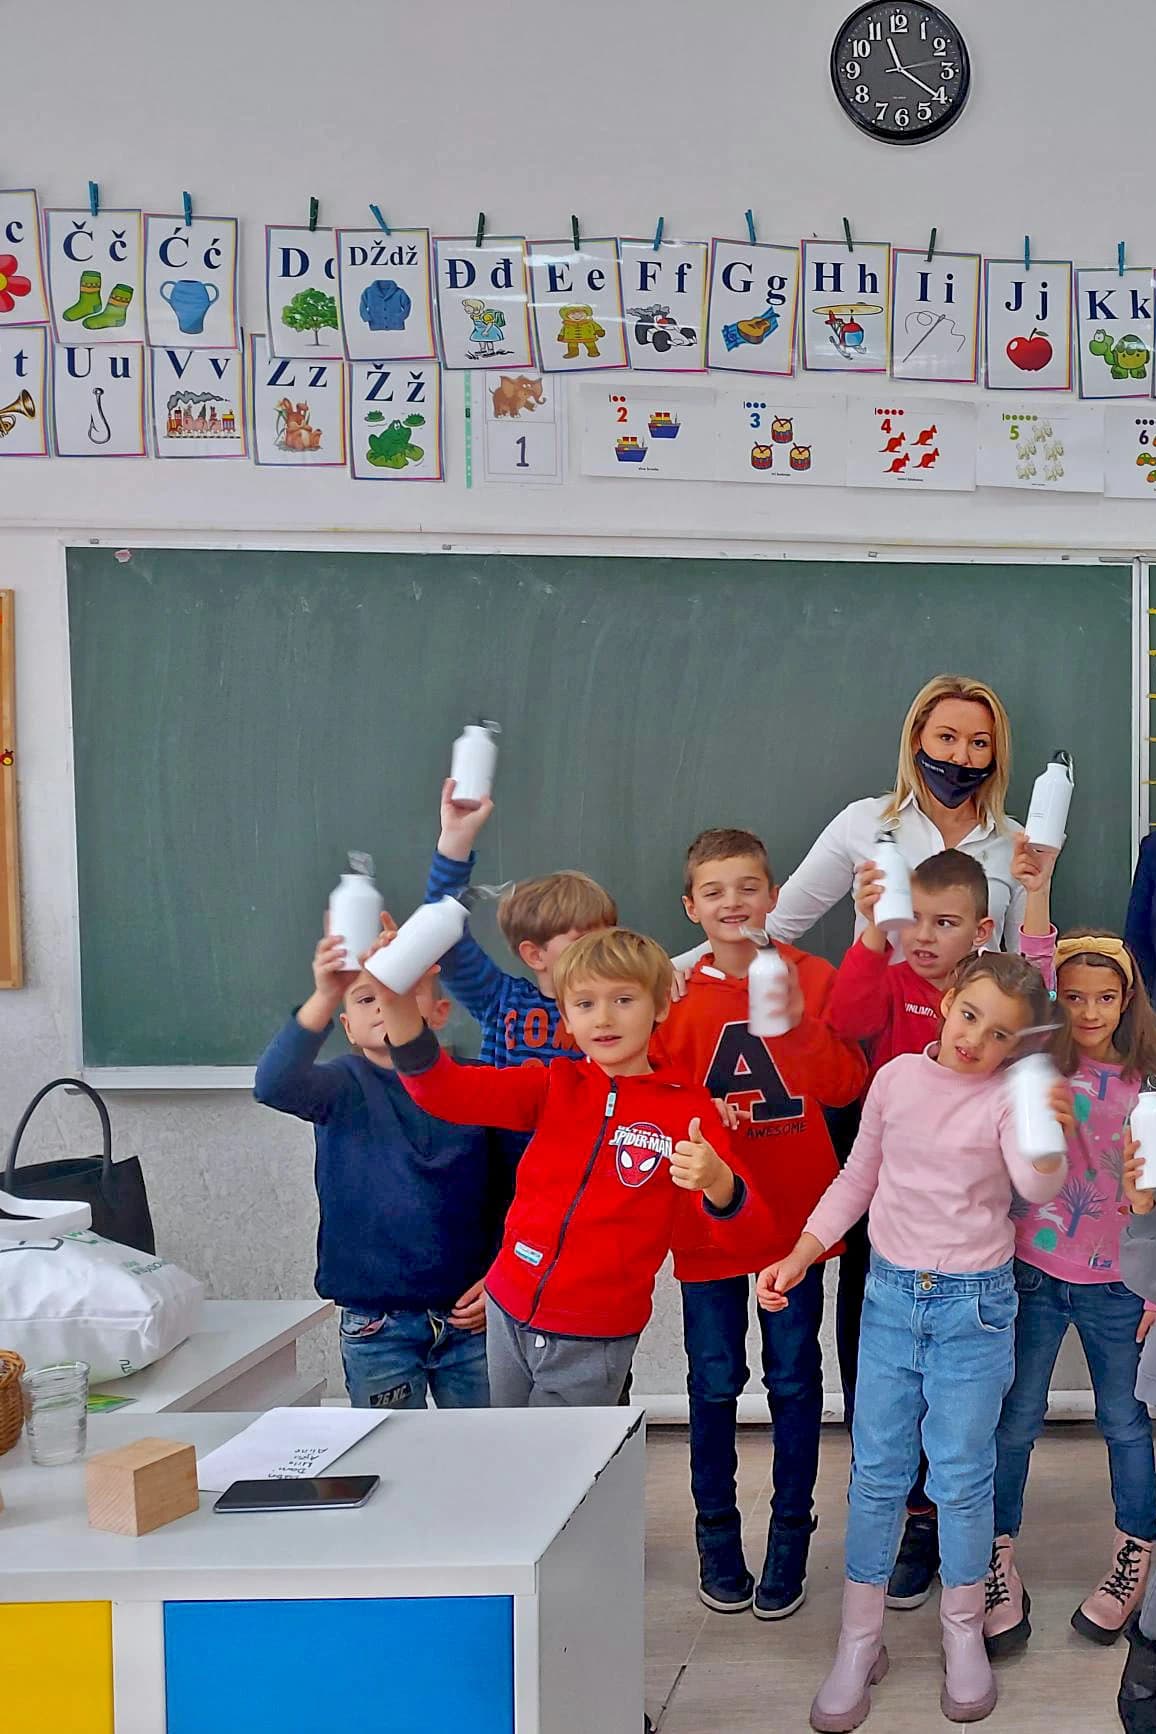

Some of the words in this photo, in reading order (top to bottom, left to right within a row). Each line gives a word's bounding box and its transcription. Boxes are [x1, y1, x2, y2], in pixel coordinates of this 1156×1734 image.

[868, 22, 881, 40] 11
[890, 14, 908, 32] 12
[920, 22, 927, 40] 1
[852, 40, 870, 58] 10
[933, 38, 946, 56] 2
[845, 62, 860, 79] 9
[940, 62, 954, 79] 3
[855, 85, 869, 103] 8
[932, 86, 948, 104] 4
[876, 102, 888, 120] 7
[895, 109, 909, 126] 6
[918, 102, 932, 120] 5
[348, 240, 418, 267] DŽdž
[616, 407, 628, 422] 2
[750, 412, 760, 428] 3
[880, 418, 892, 434] 4
[1010, 425, 1020, 440] 5
[1139, 430, 1150, 445] 6
[516, 436, 530, 467] 1
[704, 1020, 804, 1122] A
[746, 1121, 808, 1139] AWESOME
[608, 1129, 672, 1158] SPIDER-MAN
